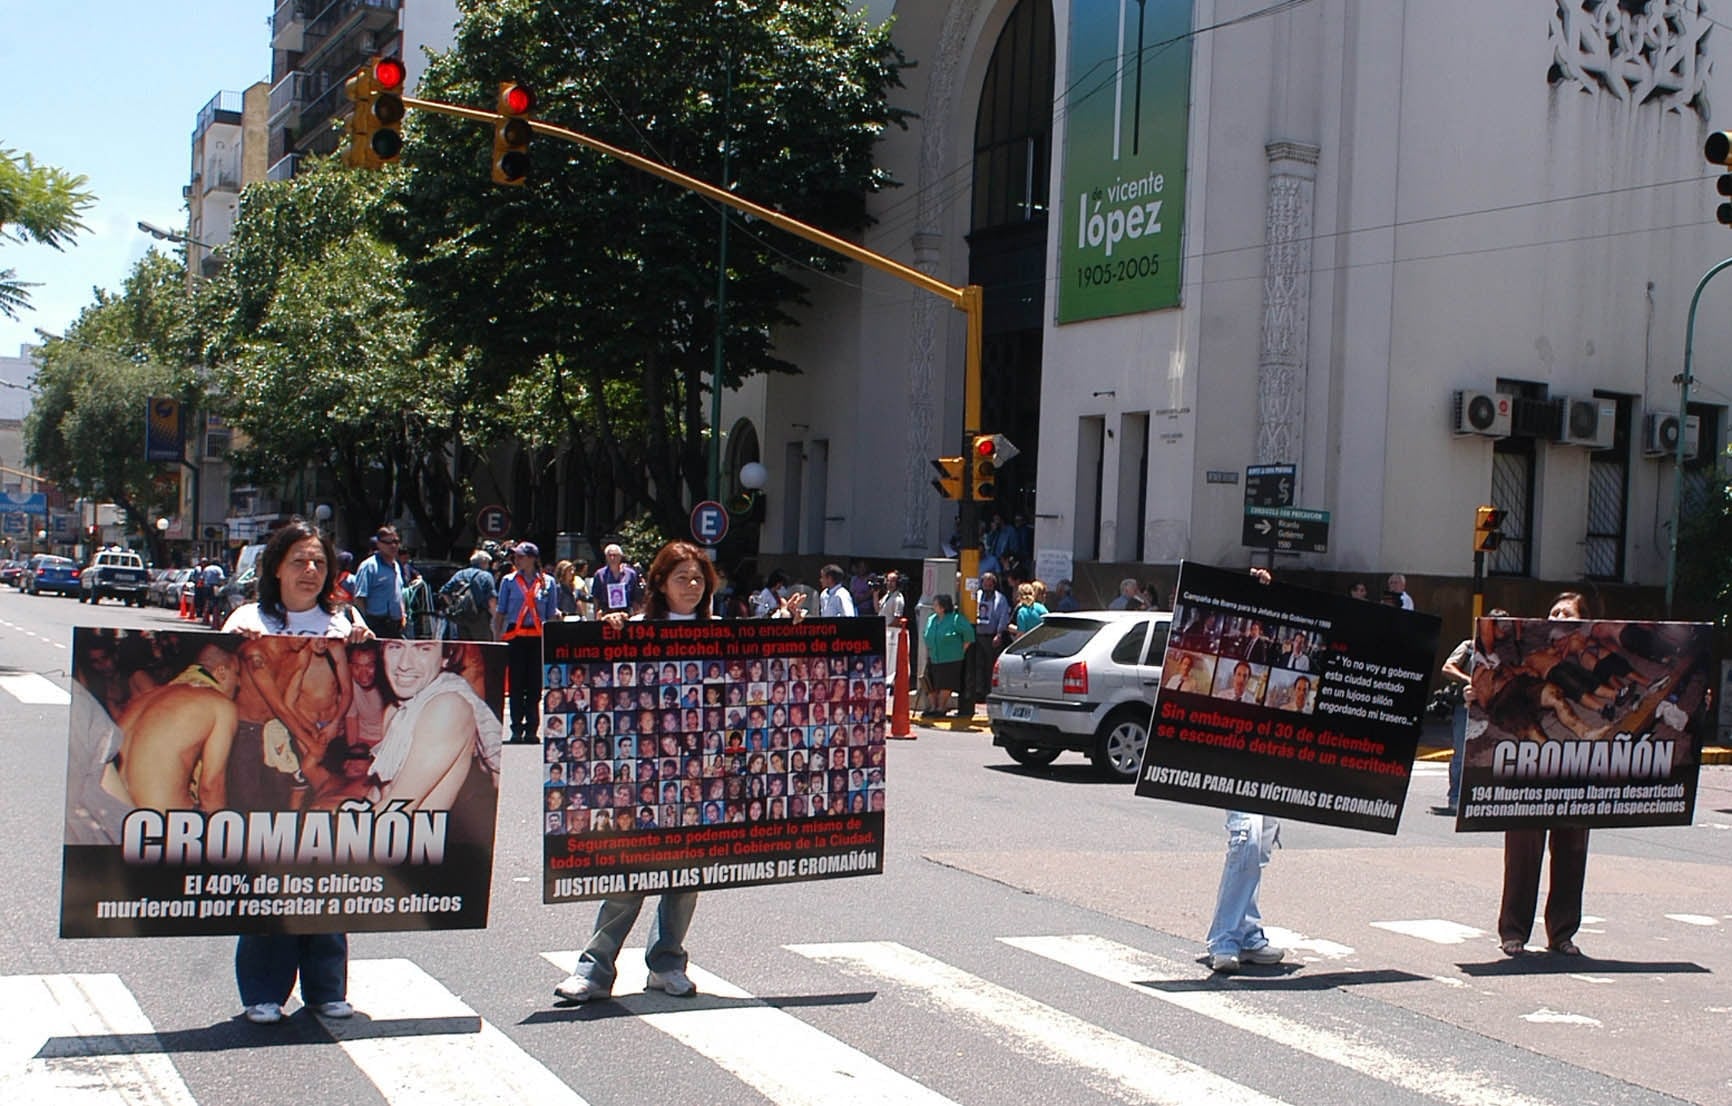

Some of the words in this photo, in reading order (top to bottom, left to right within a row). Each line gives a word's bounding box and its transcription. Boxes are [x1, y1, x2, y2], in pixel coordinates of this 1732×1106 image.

[1107, 171, 1164, 202] vicente
[1078, 192, 1163, 257] lópez
[1078, 254, 1159, 288] 1905-2005
[488, 513, 501, 531] E
[702, 511, 717, 535] E
[602, 624, 622, 640] En
[627, 624, 655, 639] 194
[660, 624, 735, 640] autopsias,
[738, 625, 756, 636] no
[759, 623, 837, 637] encontraron
[555, 644, 569, 658] ni
[574, 645, 599, 658] una
[603, 644, 638, 661] gota
[642, 642, 661, 656] de
[666, 641, 723, 657] alcohol,
[727, 640, 739, 654] ni
[742, 641, 759, 653] un
[762, 641, 807, 656] gramo
[810, 638, 827, 652] de
[831, 638, 872, 653] droga.
[1325, 671, 1344, 682] esta
[1344, 673, 1373, 688] ciudad
[1373, 680, 1405, 693] sentado
[1353, 661, 1365, 670] no
[1366, 663, 1380, 675] voy
[1381, 666, 1387, 674] a
[1388, 666, 1424, 681] gobernar
[1321, 686, 1333, 696] en
[1334, 689, 1345, 698] un
[1346, 688, 1371, 702] lujoso
[1372, 694, 1393, 707] sillón
[1319, 701, 1367, 718] engordando
[1367, 709, 1379, 720] mi
[1161, 701, 1186, 721] Sin
[1189, 711, 1254, 733] embargo
[1257, 720, 1271, 736] el
[1274, 722, 1294, 739] 30
[1296, 727, 1315, 743] de
[1317, 730, 1385, 755] diciembre
[1157, 724, 1176, 738] se
[1179, 728, 1246, 750] escondió
[1249, 738, 1295, 759] detrás
[1297, 746, 1316, 761] de
[1318, 751, 1338, 765] un
[1340, 756, 1408, 777] escritorio.
[1493, 733, 1674, 779] CROMAÑÓN
[1144, 765, 1201, 789] JUSTICIA
[1202, 774, 1235, 794] PARA
[1235, 780, 1259, 798] LAS
[1260, 782, 1317, 807] VÍCTIMAS
[1317, 792, 1334, 809] DE
[1334, 795, 1398, 819] CROMAÑÓN
[1471, 786, 1492, 801] 194
[1494, 786, 1542, 801] Muertos
[1544, 788, 1585, 801] porque
[1586, 785, 1621, 800] Ibarra
[1622, 783, 1685, 799] desarticuló
[1465, 802, 1554, 818] personalmente
[1556, 801, 1568, 816] el
[1569, 800, 1596, 815] área
[1597, 800, 1612, 815] de
[1613, 799, 1685, 815] inspecciones
[122, 799, 449, 866] CROMAÑÓN
[567, 834, 661, 853] Seguramente
[665, 832, 682, 843] no
[685, 828, 746, 845] podemos
[750, 824, 783, 838] decir
[786, 822, 798, 835] lo
[801, 820, 843, 833] mismo
[846, 817, 862, 830] de
[551, 856, 591, 869] todos
[595, 852, 616, 866] los
[620, 847, 705, 865] funcionarios
[708, 845, 729, 857] del
[733, 840, 792, 855] Gobierno
[795, 836, 812, 849] de
[815, 836, 827, 848] la
[829, 832, 876, 846] Ciudad.
[184, 875, 202, 895] El
[205, 874, 250, 895] 40%
[253, 873, 279, 894] de
[282, 873, 314, 893] los
[317, 872, 384, 894] chicos
[553, 874, 626, 898] JUSTICIA
[628, 869, 669, 891] PARA
[671, 866, 701, 887] LAS
[702, 861, 776, 884] VÍCTIMAS
[777, 859, 796, 878] DE
[797, 850, 877, 876] CROMAÑÓN
[96, 898, 196, 918] murieron
[199, 899, 236, 918] por
[238, 897, 326, 916] rescatar
[328, 898, 341, 915] a
[344, 896, 395, 915] otros
[398, 893, 462, 914] chicos
